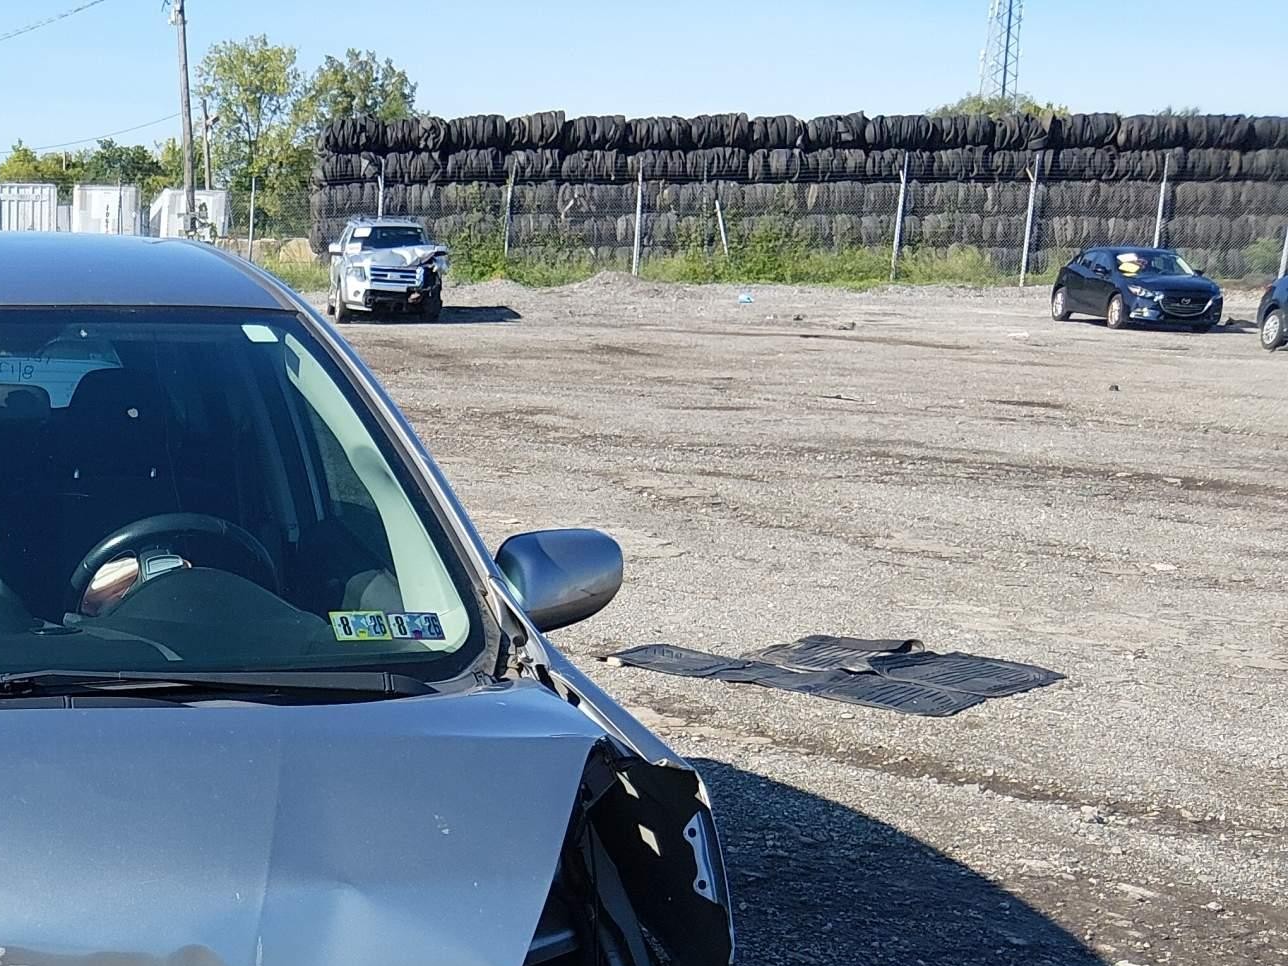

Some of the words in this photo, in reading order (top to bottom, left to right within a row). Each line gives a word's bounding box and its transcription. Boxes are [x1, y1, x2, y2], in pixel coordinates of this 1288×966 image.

[339, 616, 353, 636] 8
[368, 614, 387, 635] 26
[394, 616, 408, 636] 8
[424, 616, 443, 636] 26
